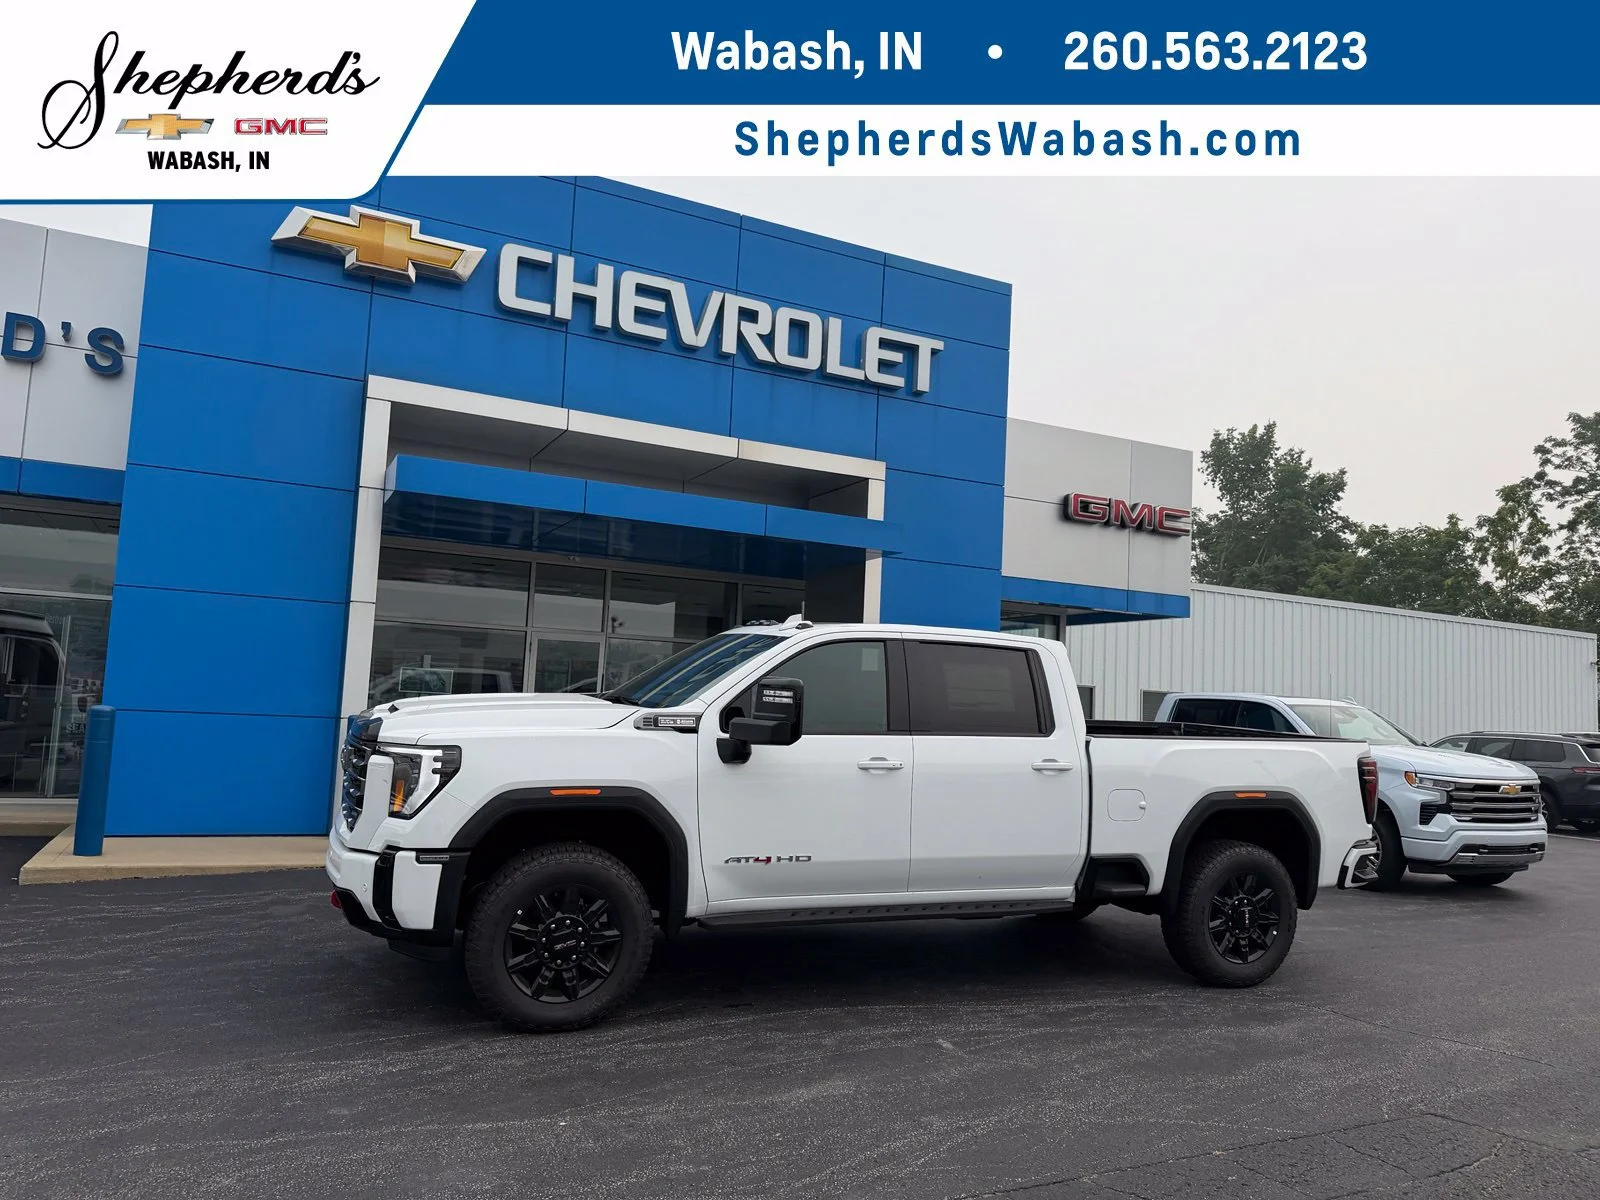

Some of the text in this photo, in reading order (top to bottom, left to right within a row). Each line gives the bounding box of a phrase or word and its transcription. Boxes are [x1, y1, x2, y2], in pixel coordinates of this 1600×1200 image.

[1, 311, 124, 376] D'S
[498, 243, 945, 393] CHEVROLET
[1066, 492, 1191, 536] GMC
[724, 855, 812, 865] AT4 HD
